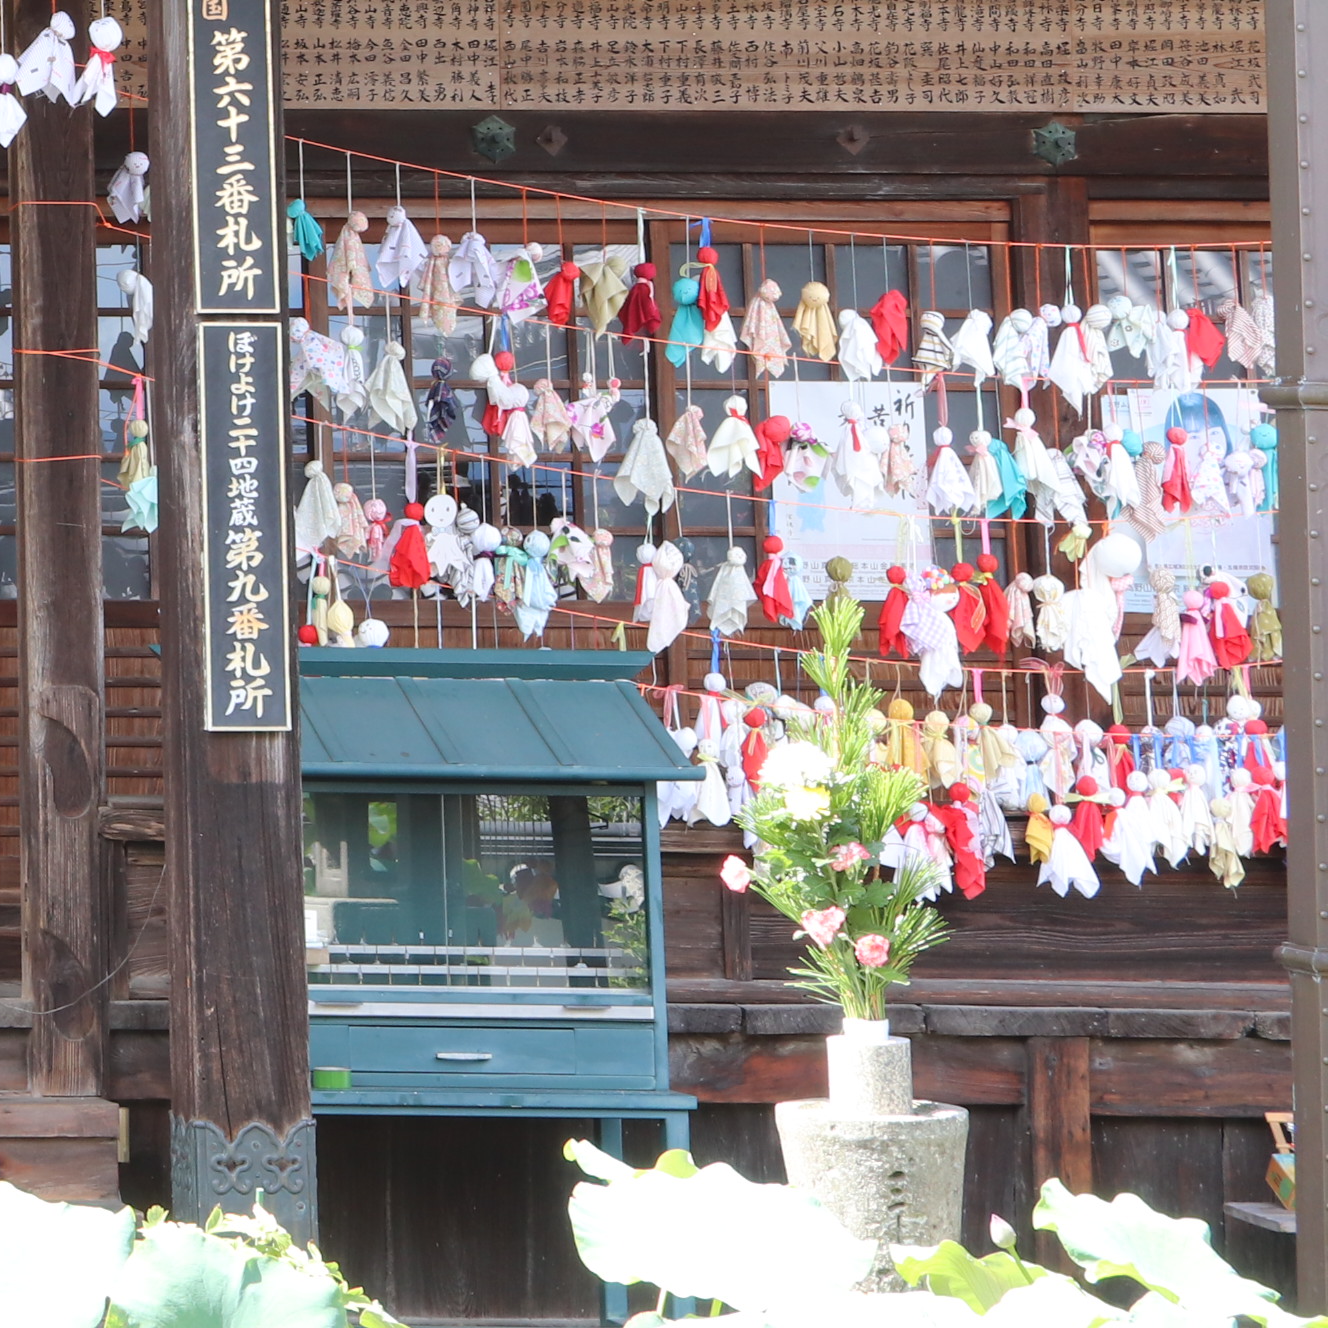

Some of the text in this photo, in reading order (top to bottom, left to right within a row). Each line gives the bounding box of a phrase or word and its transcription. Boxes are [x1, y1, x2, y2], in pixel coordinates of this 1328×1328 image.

[210, 27, 264, 301] 第六十三番札所
